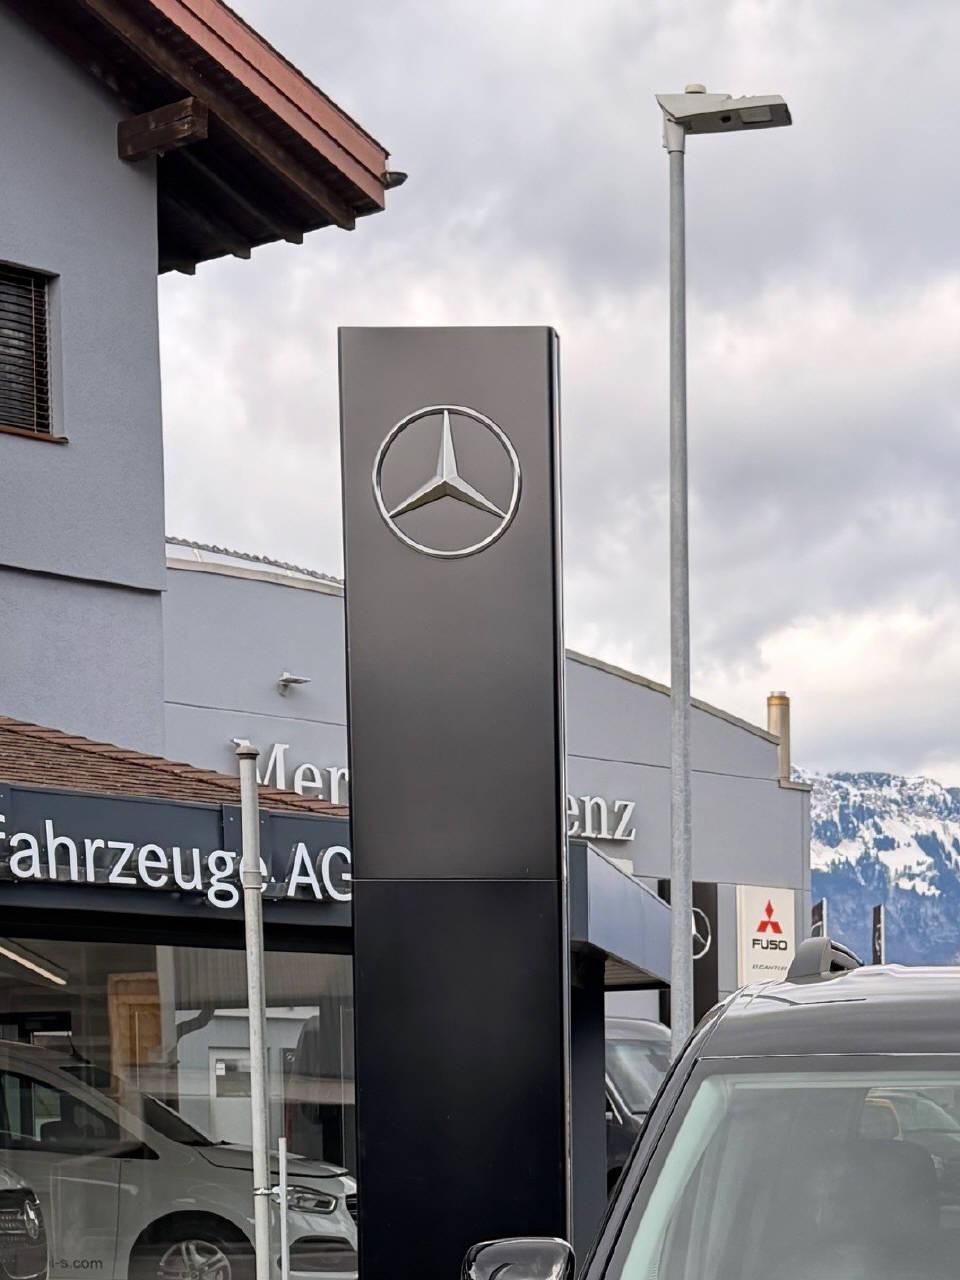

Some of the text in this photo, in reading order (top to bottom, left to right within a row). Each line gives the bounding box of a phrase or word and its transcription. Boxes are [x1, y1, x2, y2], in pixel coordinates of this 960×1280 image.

[0, 814, 352, 909] ahrzeug AG
[752, 938, 788, 951] FUSO
